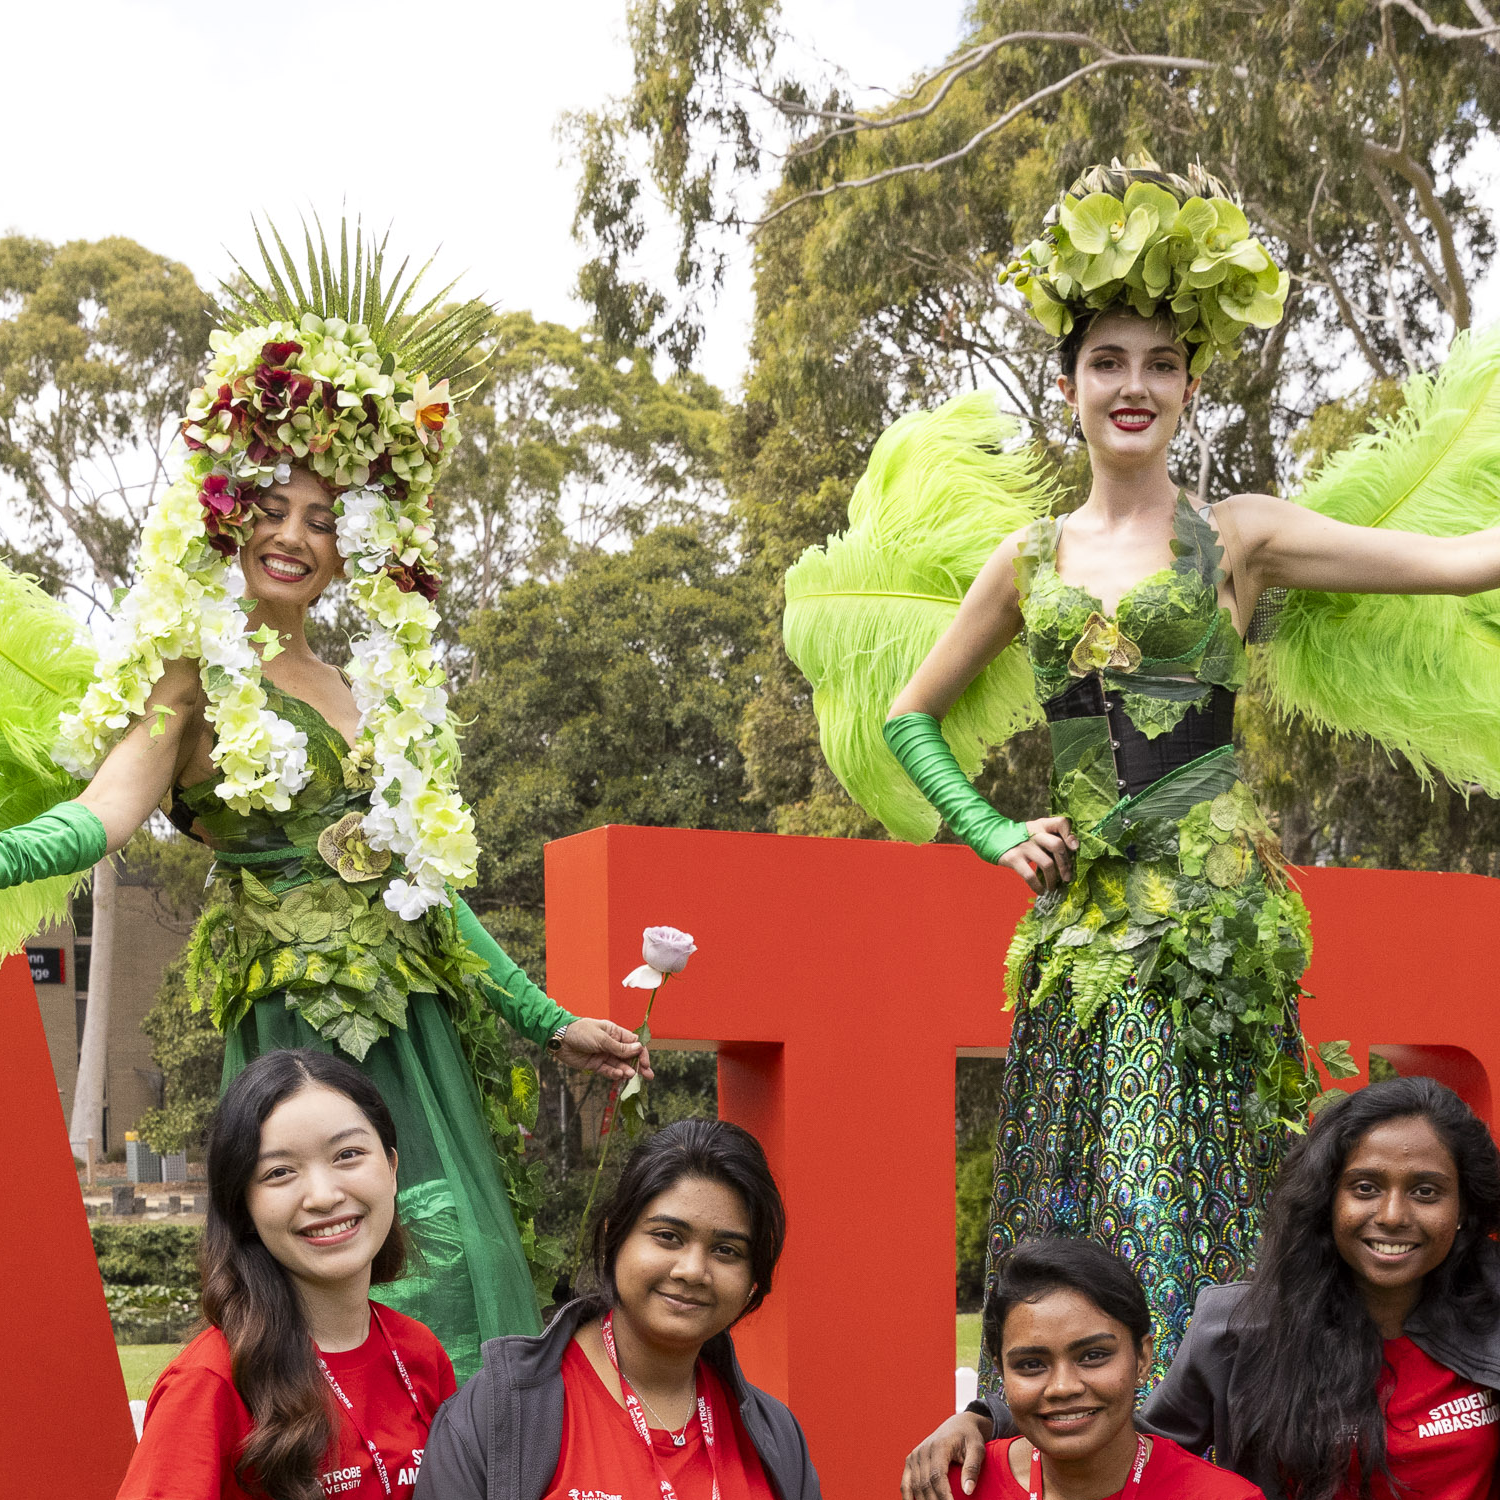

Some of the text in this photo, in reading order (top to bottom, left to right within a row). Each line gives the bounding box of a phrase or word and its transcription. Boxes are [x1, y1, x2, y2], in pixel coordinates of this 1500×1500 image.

[697, 1396, 708, 1423] TROBE
[1428, 1389, 1493, 1421] STUDENT
[633, 1406, 652, 1447] LA TROBE
[1418, 1404, 1500, 1439] AMBASSADO
[322, 1465, 362, 1485] TROBE
[380, 1464, 392, 1495] TROBE
[1132, 1456, 1145, 1485] TROBE
[581, 1490, 594, 1498] LA
